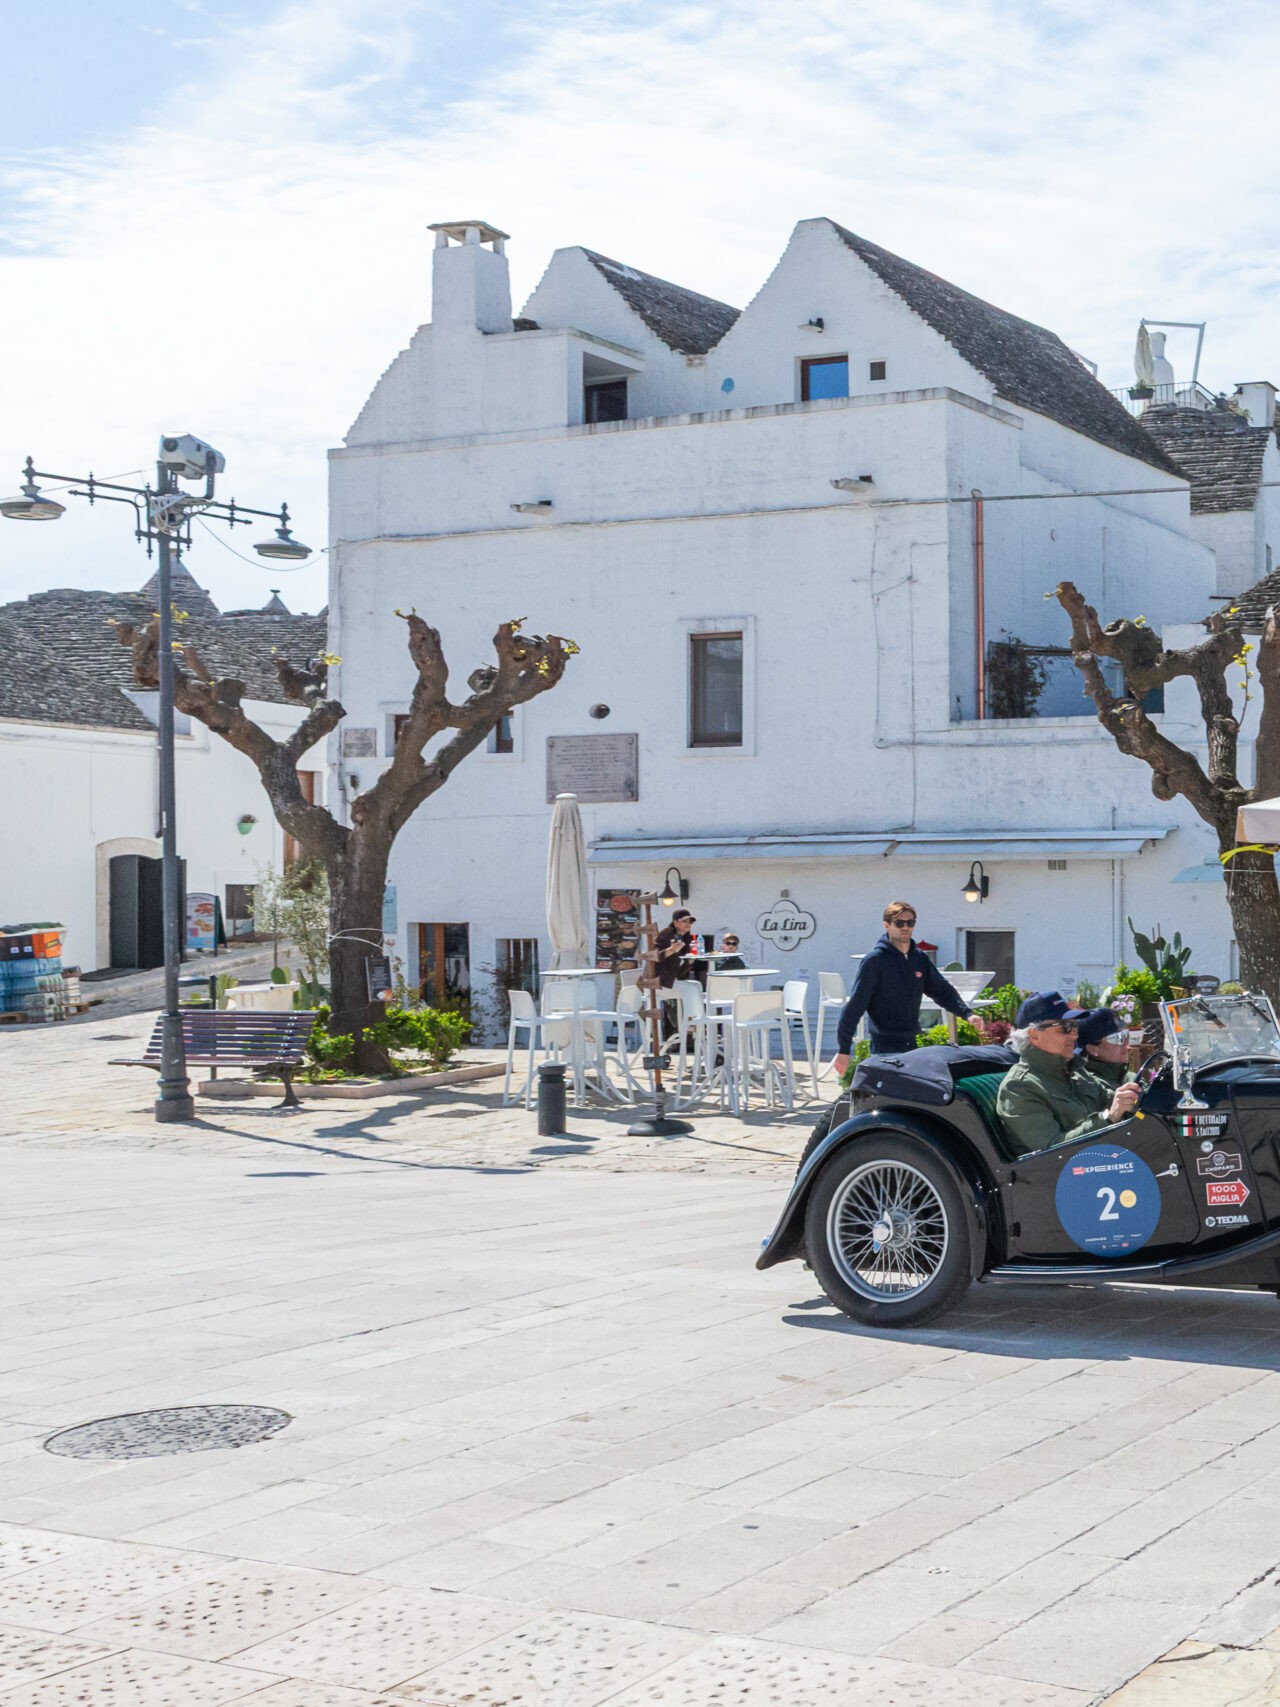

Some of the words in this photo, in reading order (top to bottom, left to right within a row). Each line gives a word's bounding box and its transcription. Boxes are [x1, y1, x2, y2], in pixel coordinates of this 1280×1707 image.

[761, 918, 778, 931] La
[780, 918, 807, 931] Lira
[1211, 1185, 1237, 1193] 1000
[1096, 1186, 1120, 1221] 2
[1211, 1194, 1240, 1203] MIGLIA
